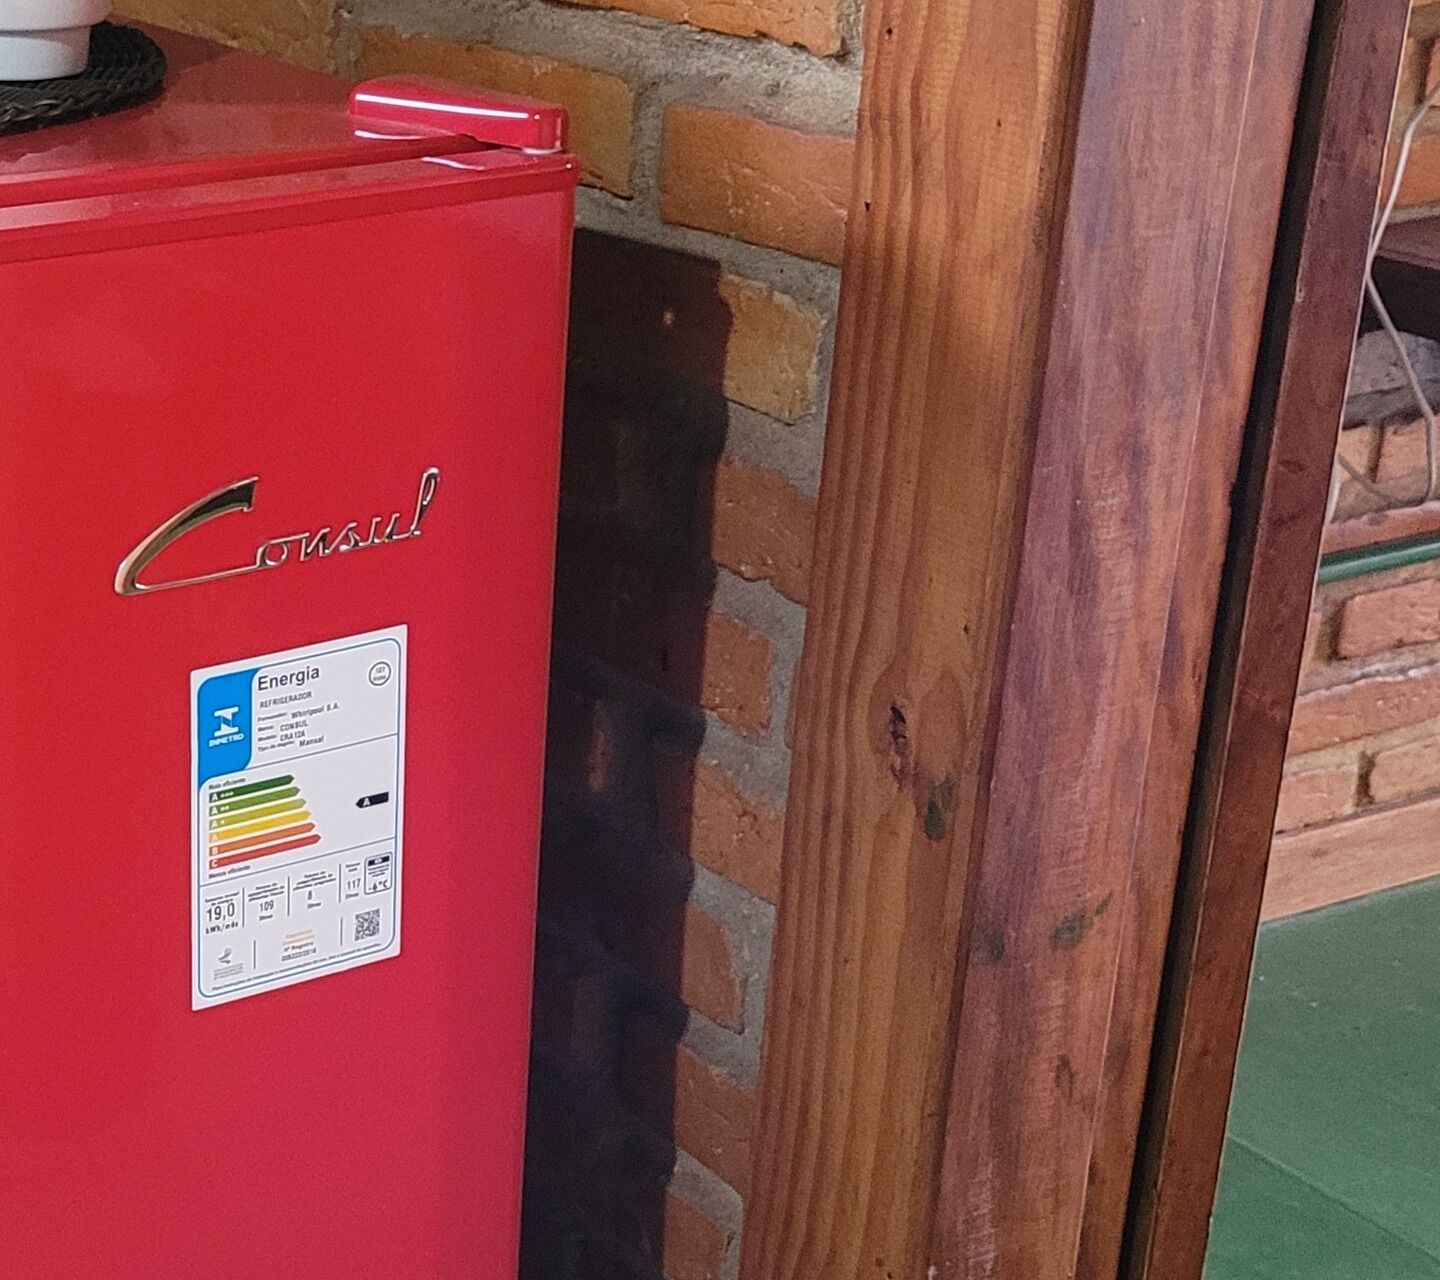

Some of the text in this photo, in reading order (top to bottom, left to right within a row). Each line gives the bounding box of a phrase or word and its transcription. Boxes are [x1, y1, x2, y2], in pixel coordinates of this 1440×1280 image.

[114, 467, 440, 596] Consul
[257, 665, 320, 691] Energia
[259, 691, 312, 708] REFRIGERADOR
[291, 705, 324, 719] Whirlpool
[279, 720, 308, 732] CONSUL
[299, 735, 324, 747] Manual
[362, 796, 371, 807] A
[211, 846, 218, 856] B
[211, 859, 219, 868] C
[347, 878, 361, 890] 117
[259, 899, 274, 912] 109
[206, 902, 236, 922] 19,0
